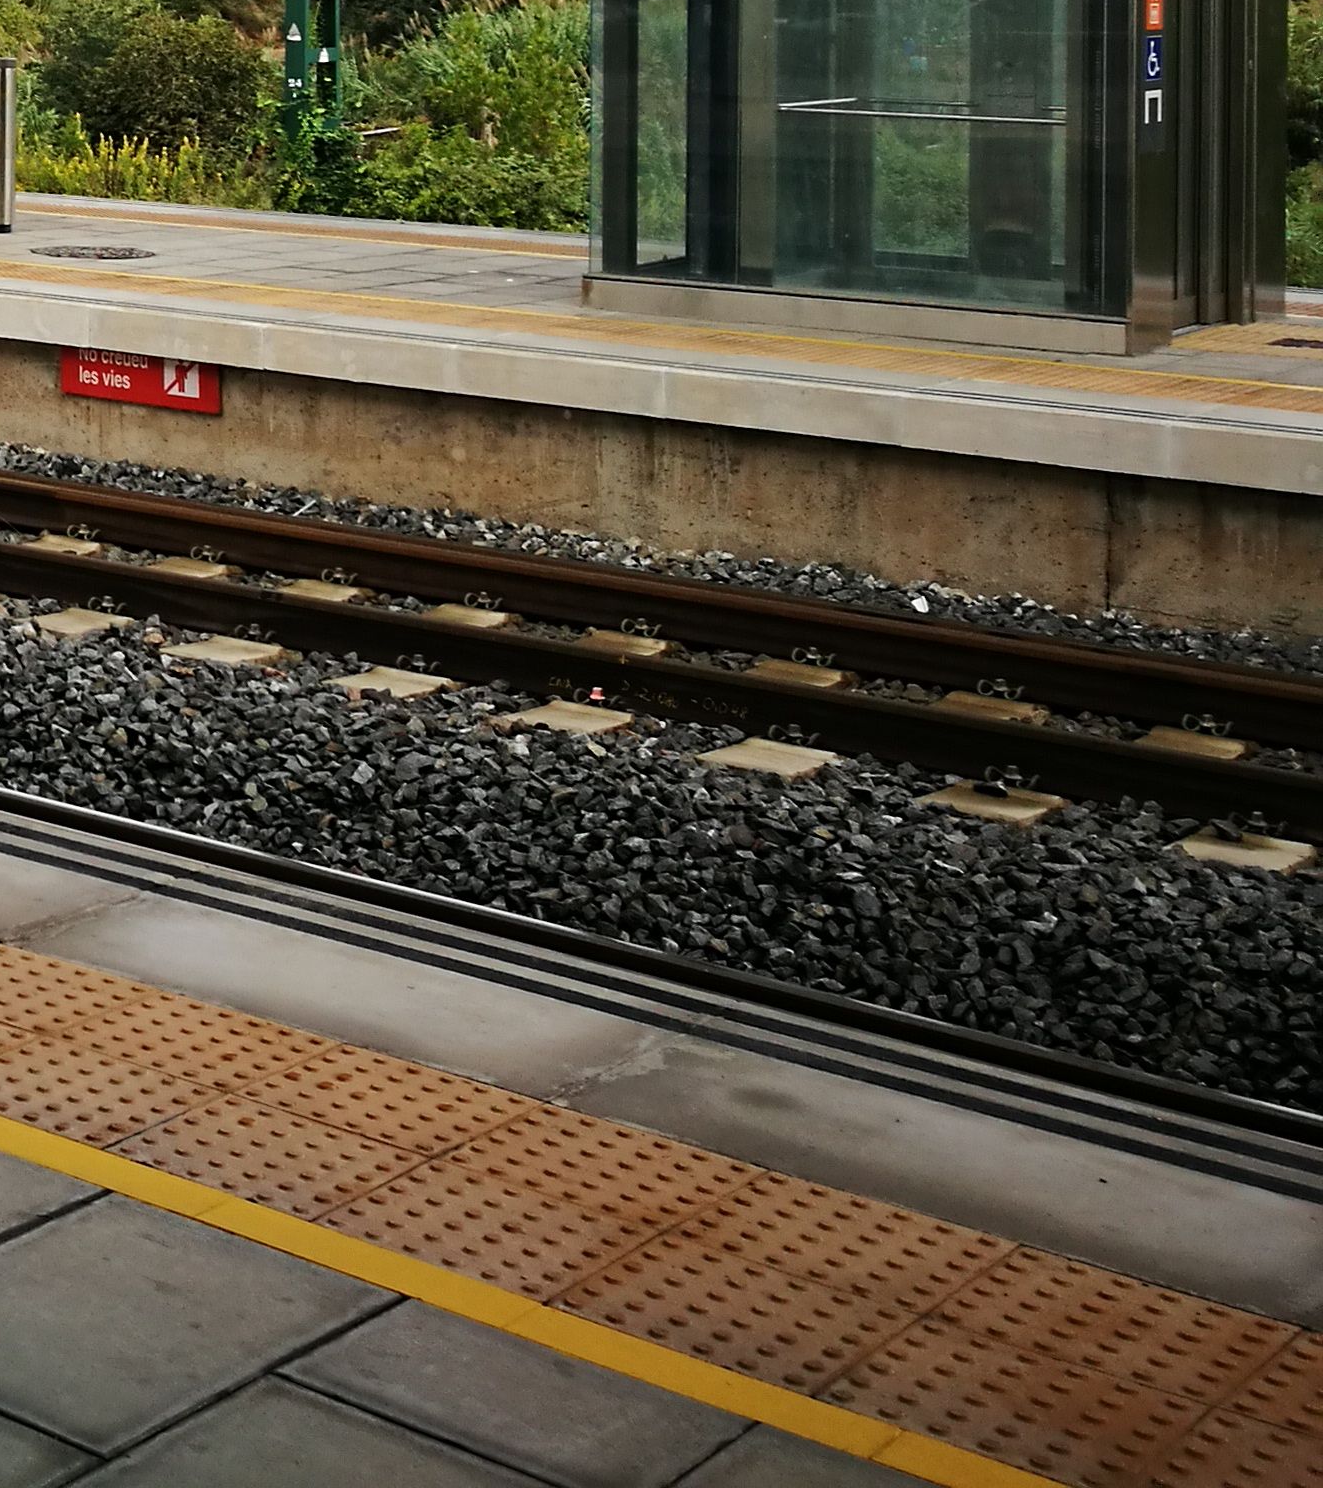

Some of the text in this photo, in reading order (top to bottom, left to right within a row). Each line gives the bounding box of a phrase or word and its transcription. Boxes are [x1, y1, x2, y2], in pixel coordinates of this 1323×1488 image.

[78, 348, 148, 369] No creueu
[78, 365, 131, 390] les vies
